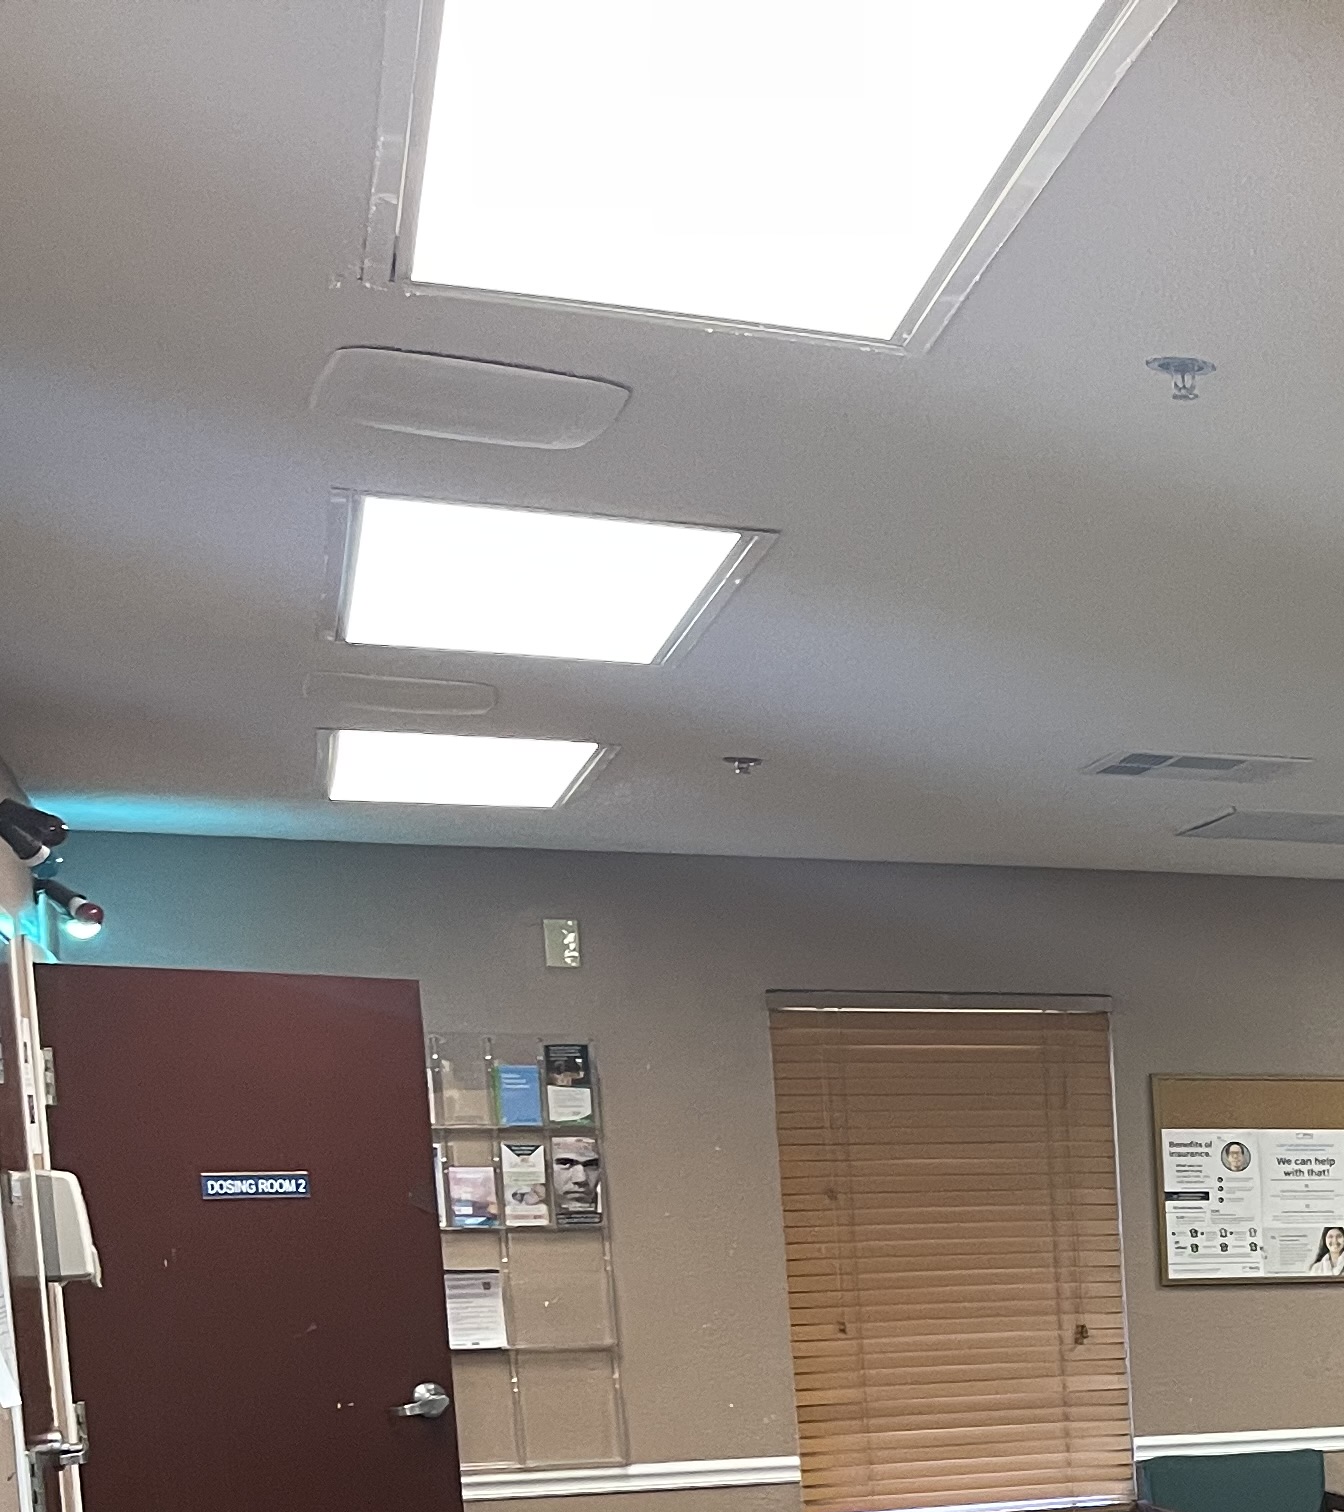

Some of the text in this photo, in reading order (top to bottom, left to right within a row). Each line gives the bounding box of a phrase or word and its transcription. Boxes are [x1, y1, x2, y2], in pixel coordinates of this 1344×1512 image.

[1168, 1140, 1213, 1148] Benefits of
[1276, 1156, 1336, 1169] We can help
[1283, 1167, 1330, 1177] with that!
[207, 1178, 307, 1194] DOSING ROOM 2
